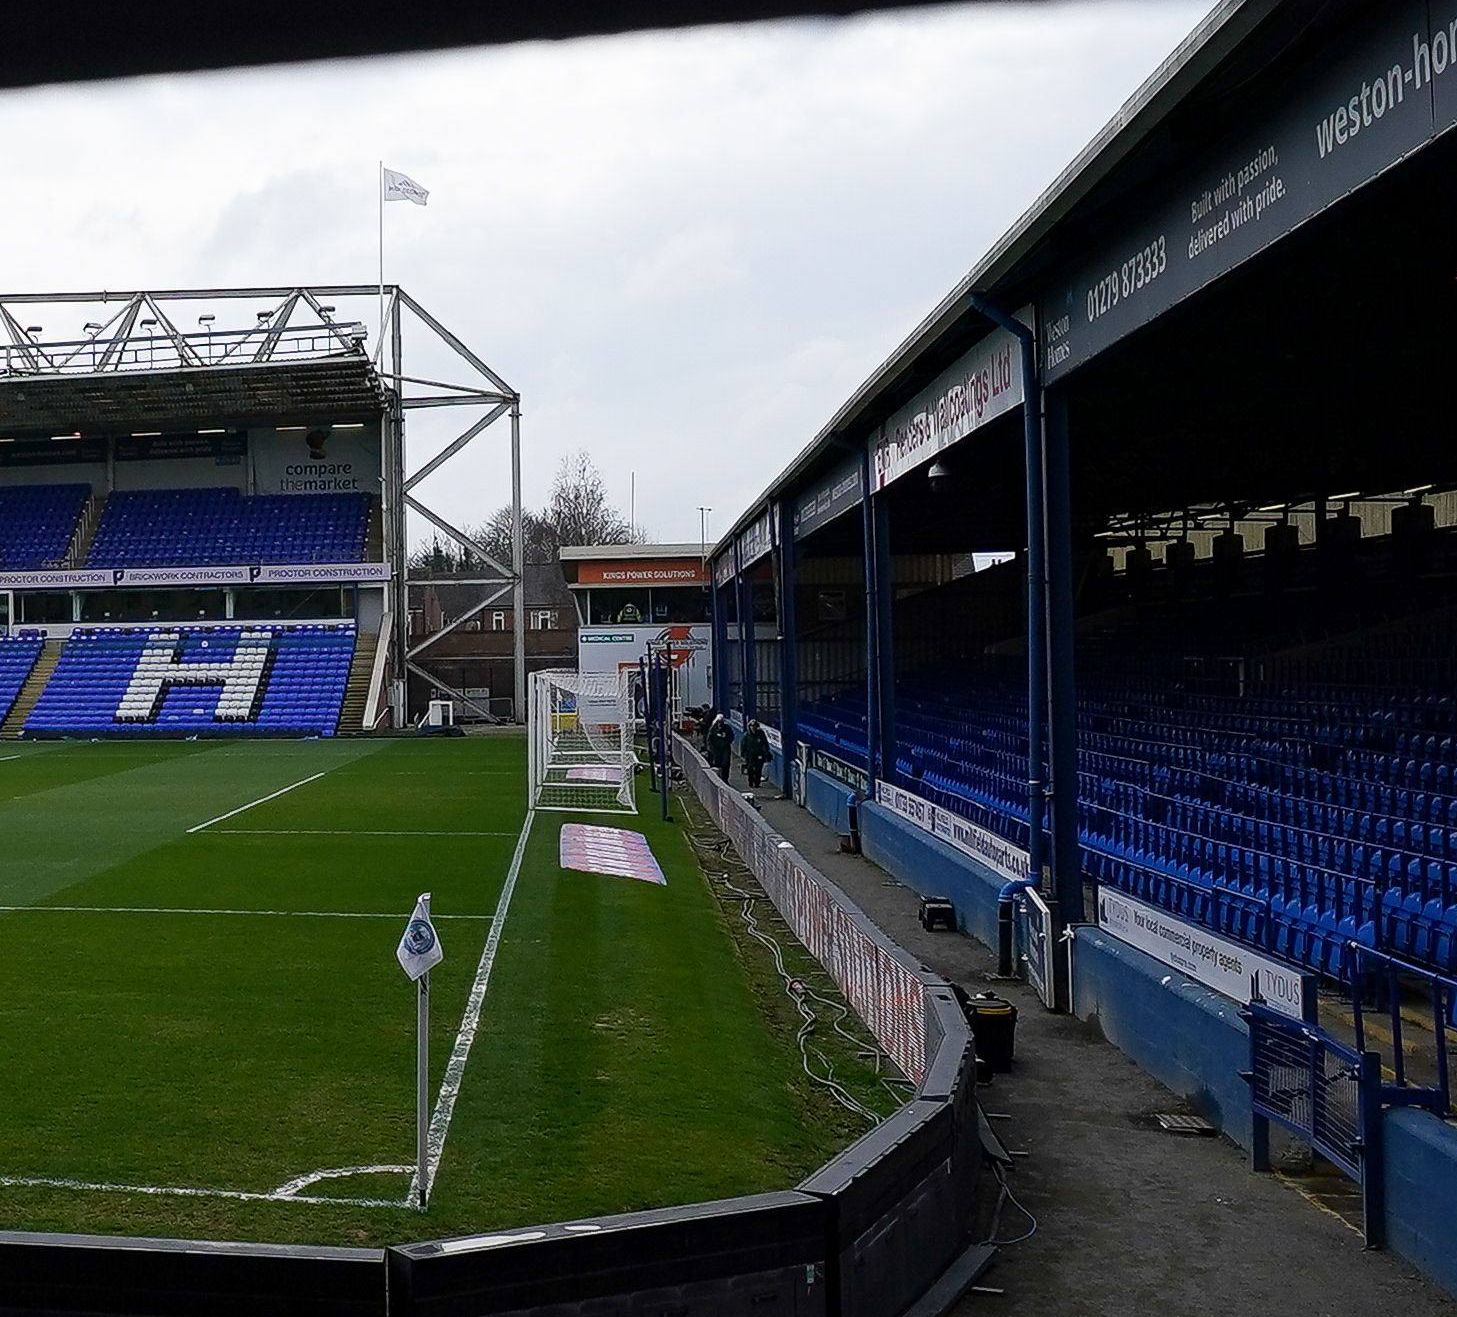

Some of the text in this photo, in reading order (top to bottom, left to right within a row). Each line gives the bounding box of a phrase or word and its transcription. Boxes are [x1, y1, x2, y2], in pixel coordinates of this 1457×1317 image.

[1191, 145, 1279, 224] Built with passion,
[1188, 176, 1286, 260] delivered with pride.
[1088, 234, 1167, 323] 01279 873333
[1047, 341, 1071, 370] Homes
[991, 344, 1011, 397] Ltd
[285, 463, 352, 480] compare
[280, 475, 359, 493] themarket
[38, 573, 106, 583] CONSTRUCTION
[129, 570, 244, 581] BRICKWORK CONTRACTORS
[268, 566, 384, 577] PROCTOR CONSTRUCTION
[654, 569, 696, 579] SOLUTIONS
[1218, 952, 1243, 976] agents
[1264, 969, 1301, 1007] TYDUS
